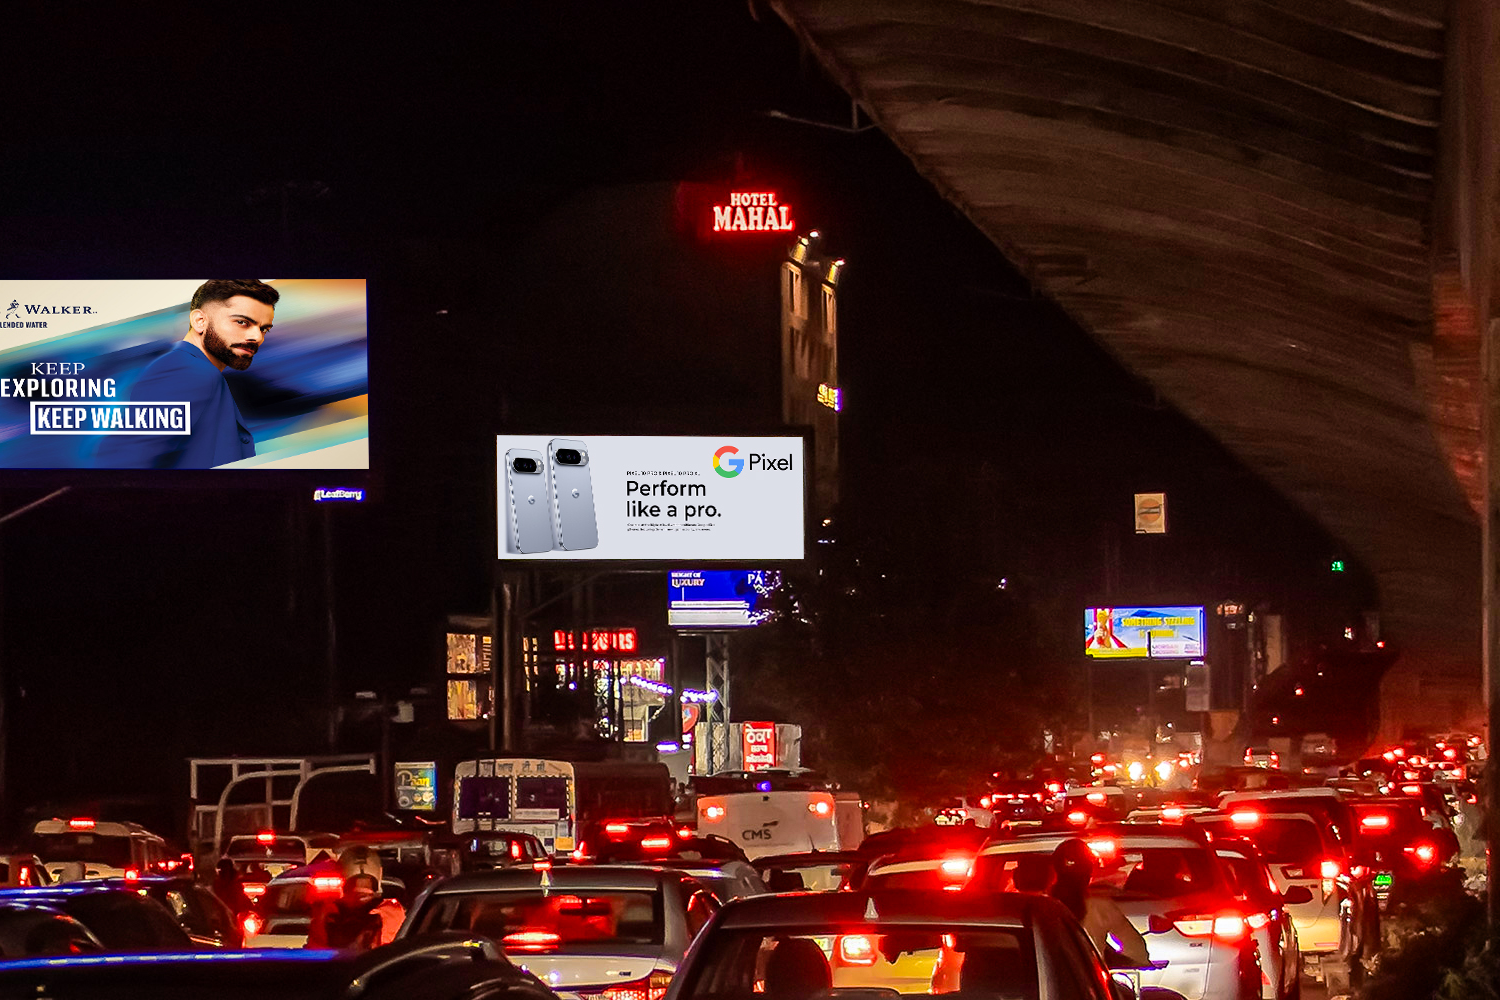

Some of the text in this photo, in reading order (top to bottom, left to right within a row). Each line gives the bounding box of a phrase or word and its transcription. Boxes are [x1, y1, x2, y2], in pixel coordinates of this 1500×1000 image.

[730, 192, 777, 206] HOTEL
[713, 206, 794, 231] MAHAL
[25, 321, 48, 329] WATER
[30, 362, 86, 376] KEEP
[0, 378, 116, 398] EXPLORING
[37, 407, 183, 429] KEEP WALKING
[712, 445, 793, 478] G Pixel
[626, 480, 706, 496] Perform
[626, 500, 722, 521] like a pro.
[671, 579, 705, 588] LUXURY
[742, 829, 772, 840] CMS
